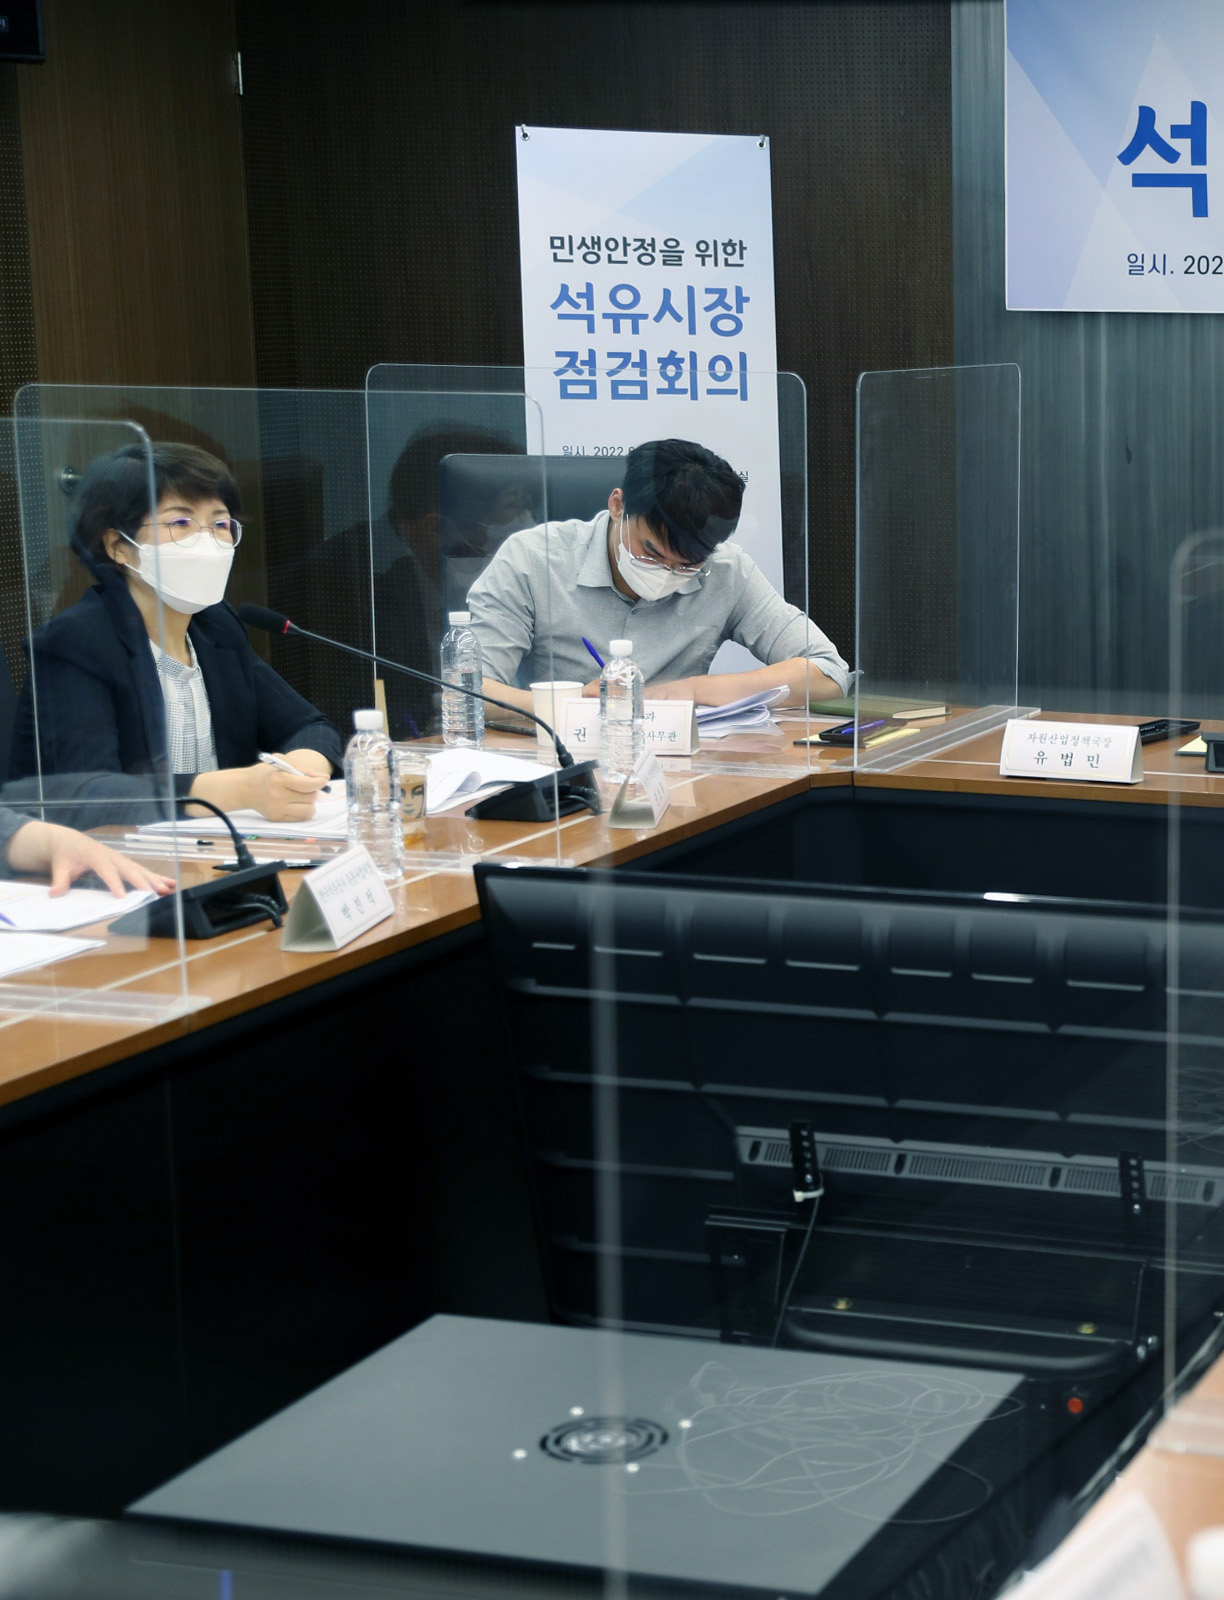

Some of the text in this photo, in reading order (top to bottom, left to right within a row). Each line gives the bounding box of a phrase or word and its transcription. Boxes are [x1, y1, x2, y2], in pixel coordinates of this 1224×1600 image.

[549, 235, 748, 267] 민생안정을 위한
[1126, 252, 1174, 276] 일시.
[550, 282, 750, 338] 석유시장
[553, 349, 749, 401] 점검회의
[573, 727, 677, 743] 권 사무관
[1027, 732, 1113, 748] 자원산업정책국장
